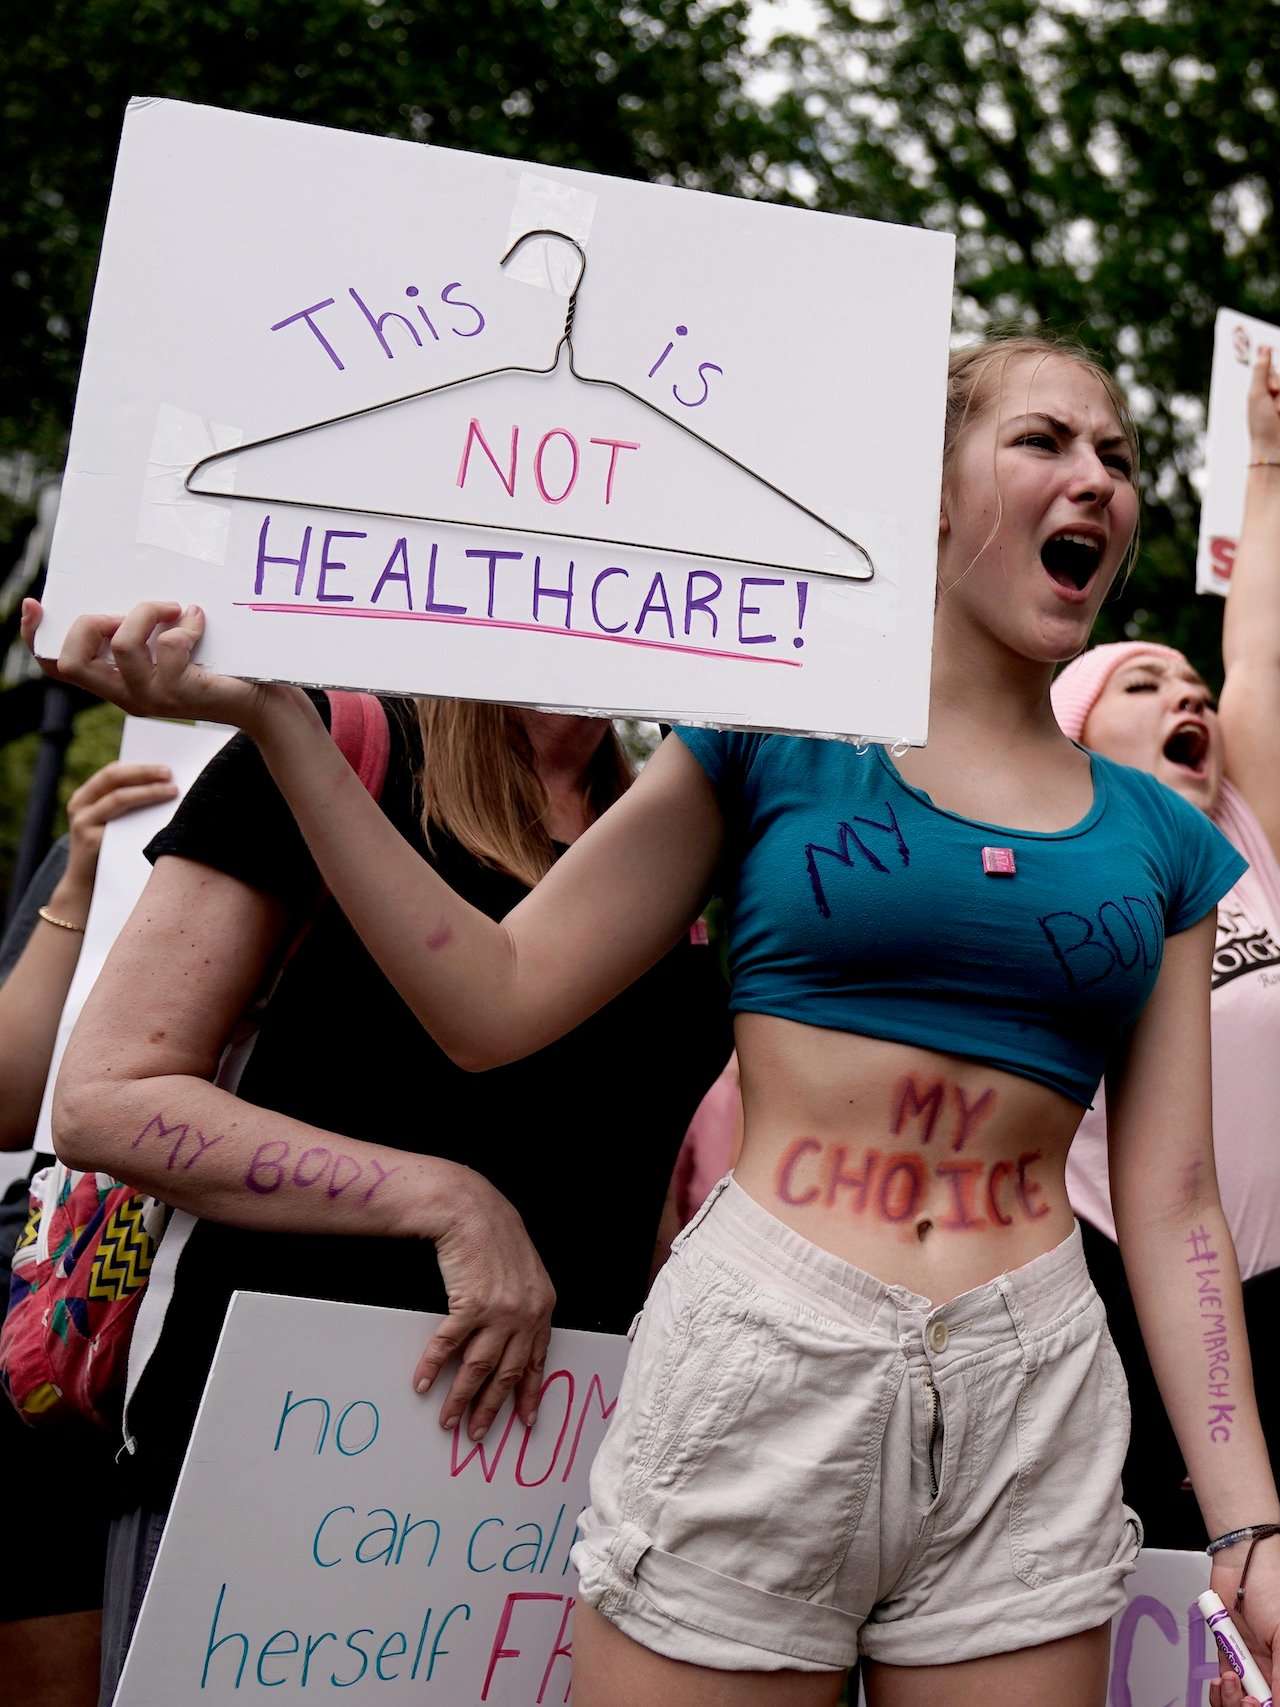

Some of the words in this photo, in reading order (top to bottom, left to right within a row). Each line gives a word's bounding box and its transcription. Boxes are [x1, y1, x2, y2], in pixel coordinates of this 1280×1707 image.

[271, 282, 486, 370] This
[649, 325, 723, 407] is
[457, 418, 640, 504] NOT
[255, 515, 808, 648] HEALTHCARE!
[805, 801, 911, 918] MY
[889, 1072, 998, 1151] MY
[131, 1112, 225, 1170] MY
[245, 1141, 402, 1211] BODY
[774, 1136, 1051, 1233] CHOICE
[274, 1390, 380, 1456] no
[313, 1506, 441, 1568] can
[201, 1583, 471, 1689] herself
